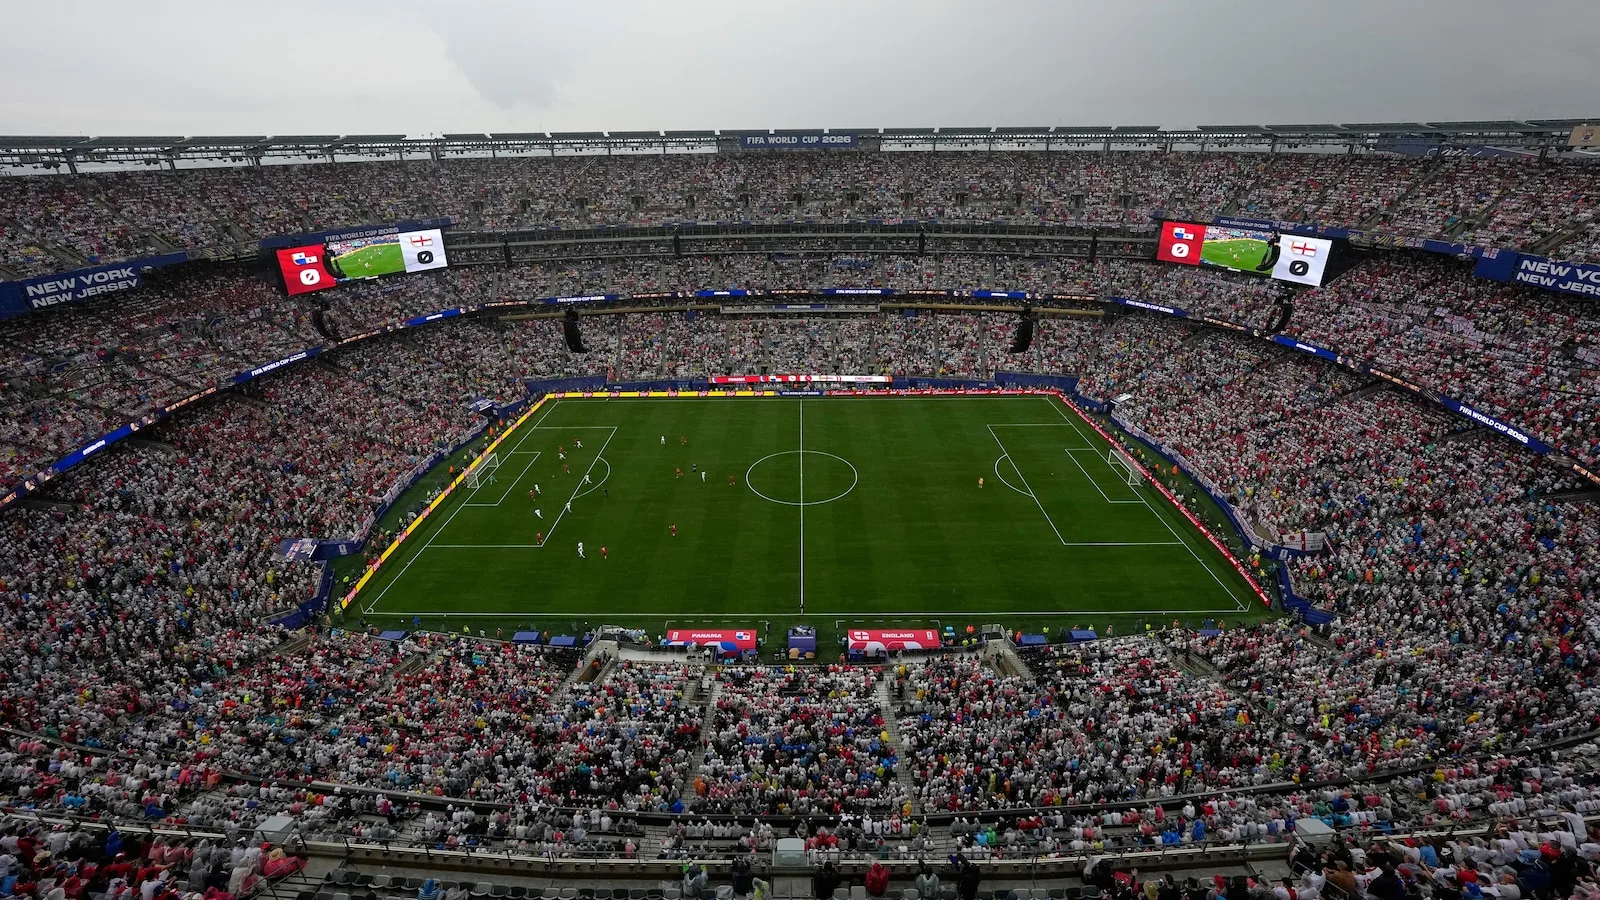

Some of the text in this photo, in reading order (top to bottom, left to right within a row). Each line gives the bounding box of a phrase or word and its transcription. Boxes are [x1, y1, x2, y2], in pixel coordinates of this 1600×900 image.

[747, 136, 765, 144] FIFA
[768, 136, 798, 144] WORLD
[340, 232, 364, 240] WORLD
[1520, 260, 1571, 276] NEW
[26, 267, 136, 296] NEW YORK
[1516, 272, 1557, 286] NEW
[32, 279, 138, 308] NEW JERSEY
[1459, 406, 1529, 444] FIFA WORLD CUP 2026
